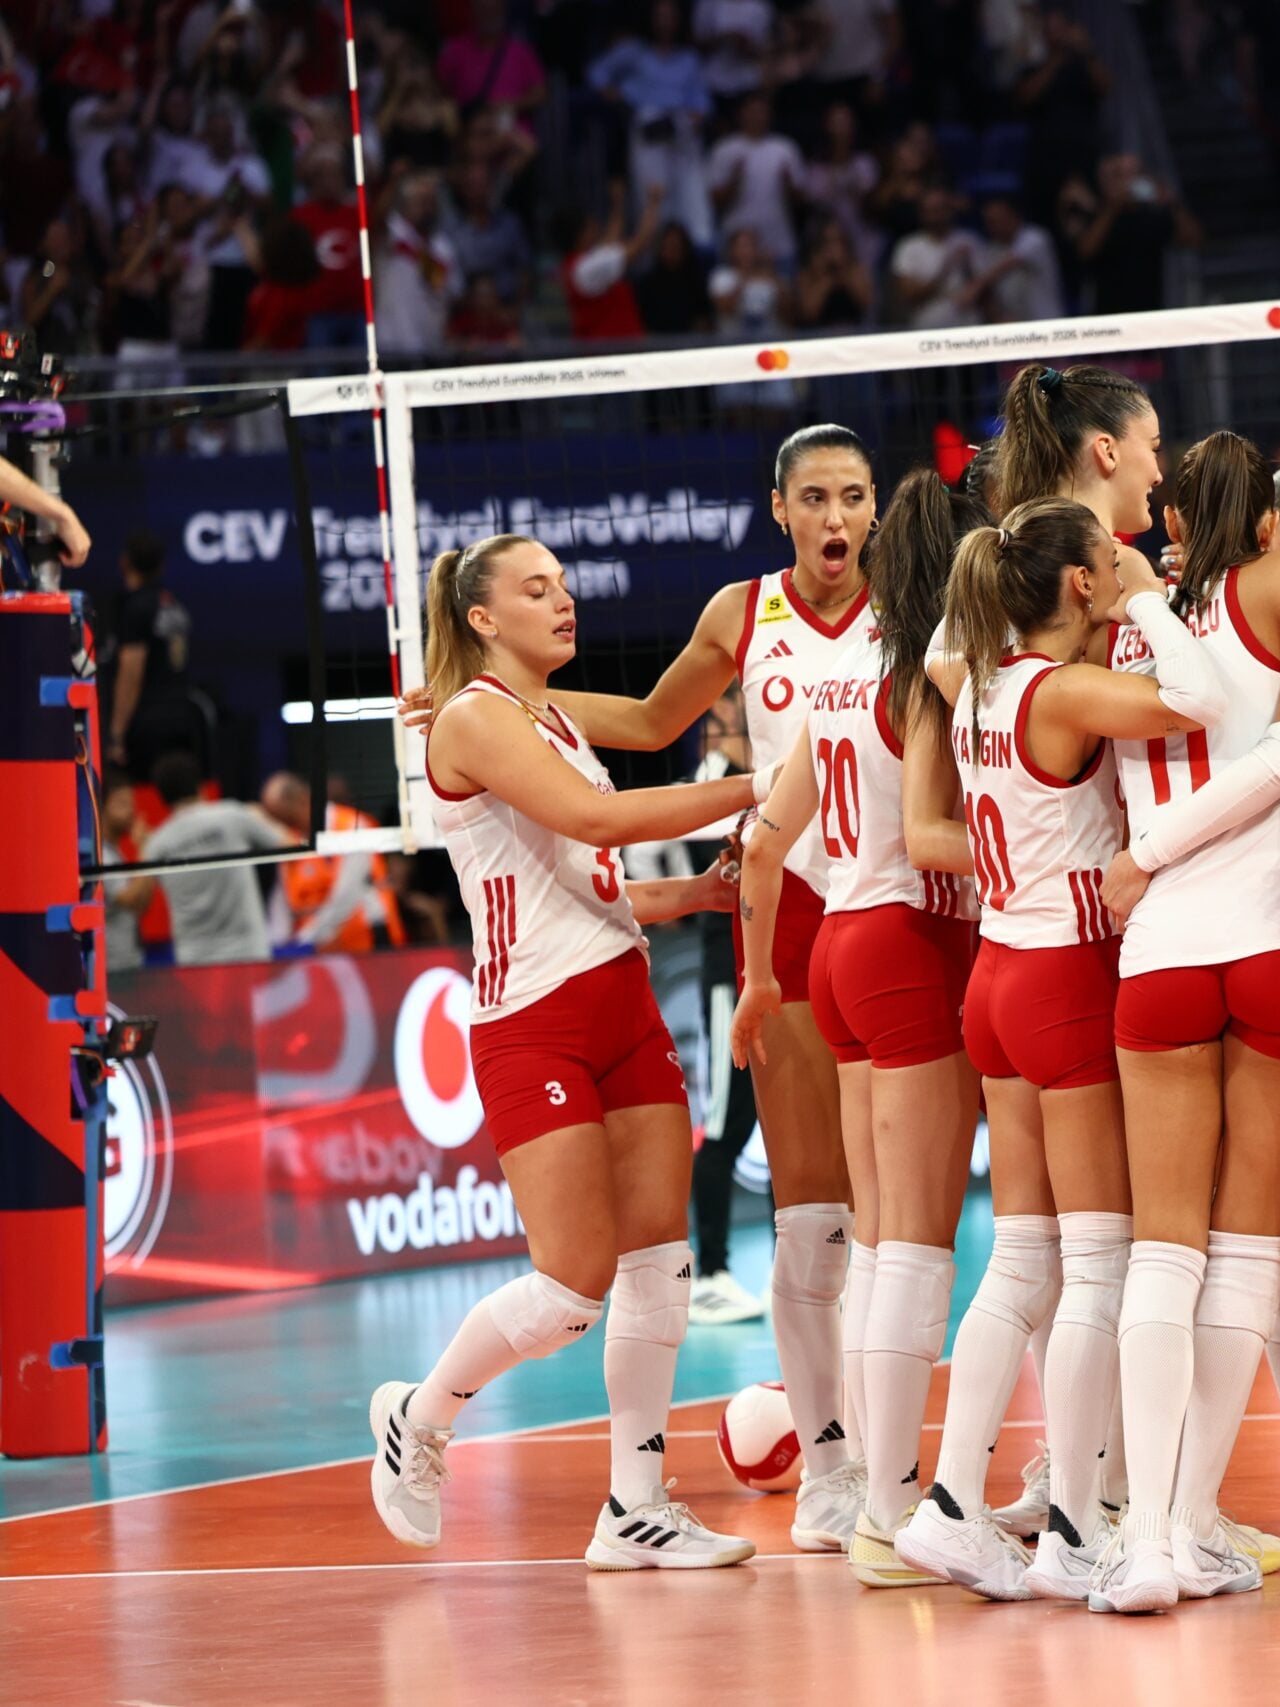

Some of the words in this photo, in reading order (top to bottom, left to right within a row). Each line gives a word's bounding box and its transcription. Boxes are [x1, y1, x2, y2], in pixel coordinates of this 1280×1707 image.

[184, 511, 287, 563] CEV
[508, 488, 753, 551] EuroVolley
[952, 724, 1012, 770] YAGIN
[816, 737, 861, 860] 20
[964, 791, 1017, 912] 10
[545, 1080, 567, 1106] 3
[346, 1164, 527, 1256] vodafon
